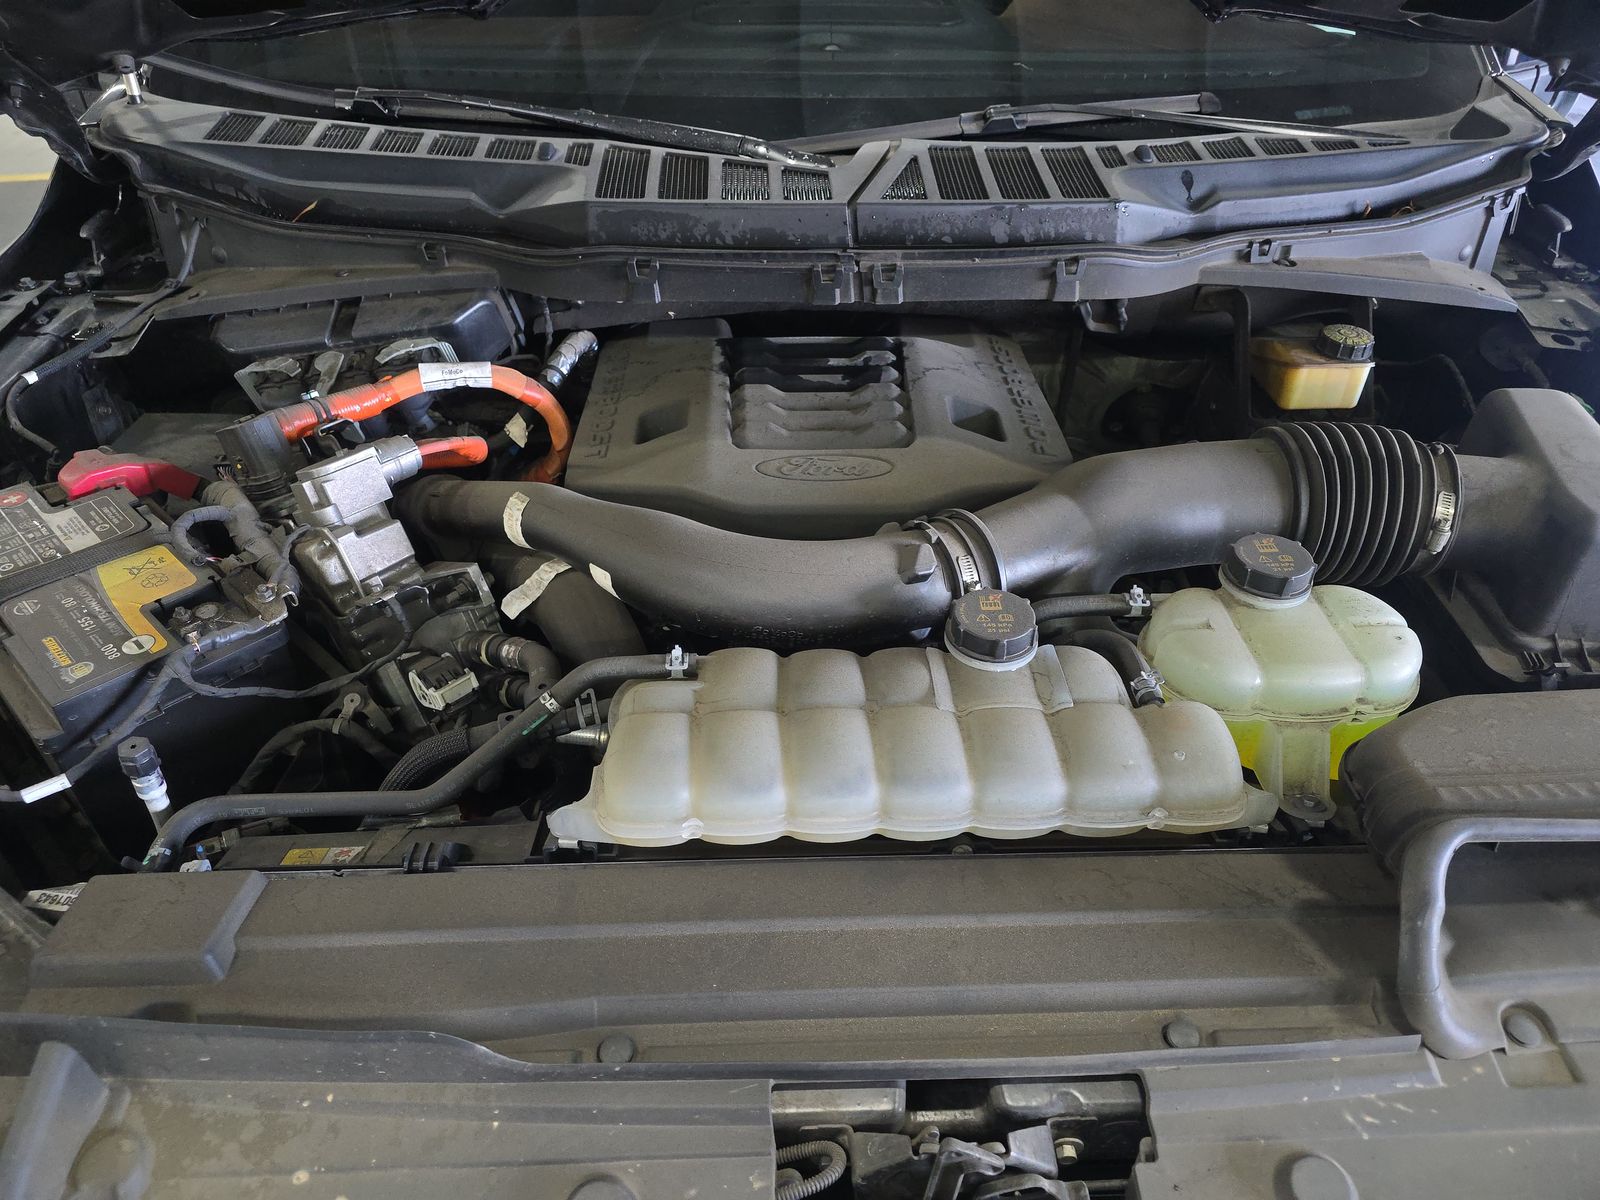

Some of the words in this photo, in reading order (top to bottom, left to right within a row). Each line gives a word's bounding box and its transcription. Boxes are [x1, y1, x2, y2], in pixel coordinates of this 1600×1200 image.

[776, 457, 870, 477] Ford
[73, 583, 111, 621] TECHNOLOGY
[77, 614, 96, 631] 155
[42, 637, 71, 667] BATTERIES
[101, 643, 121, 660] 800
